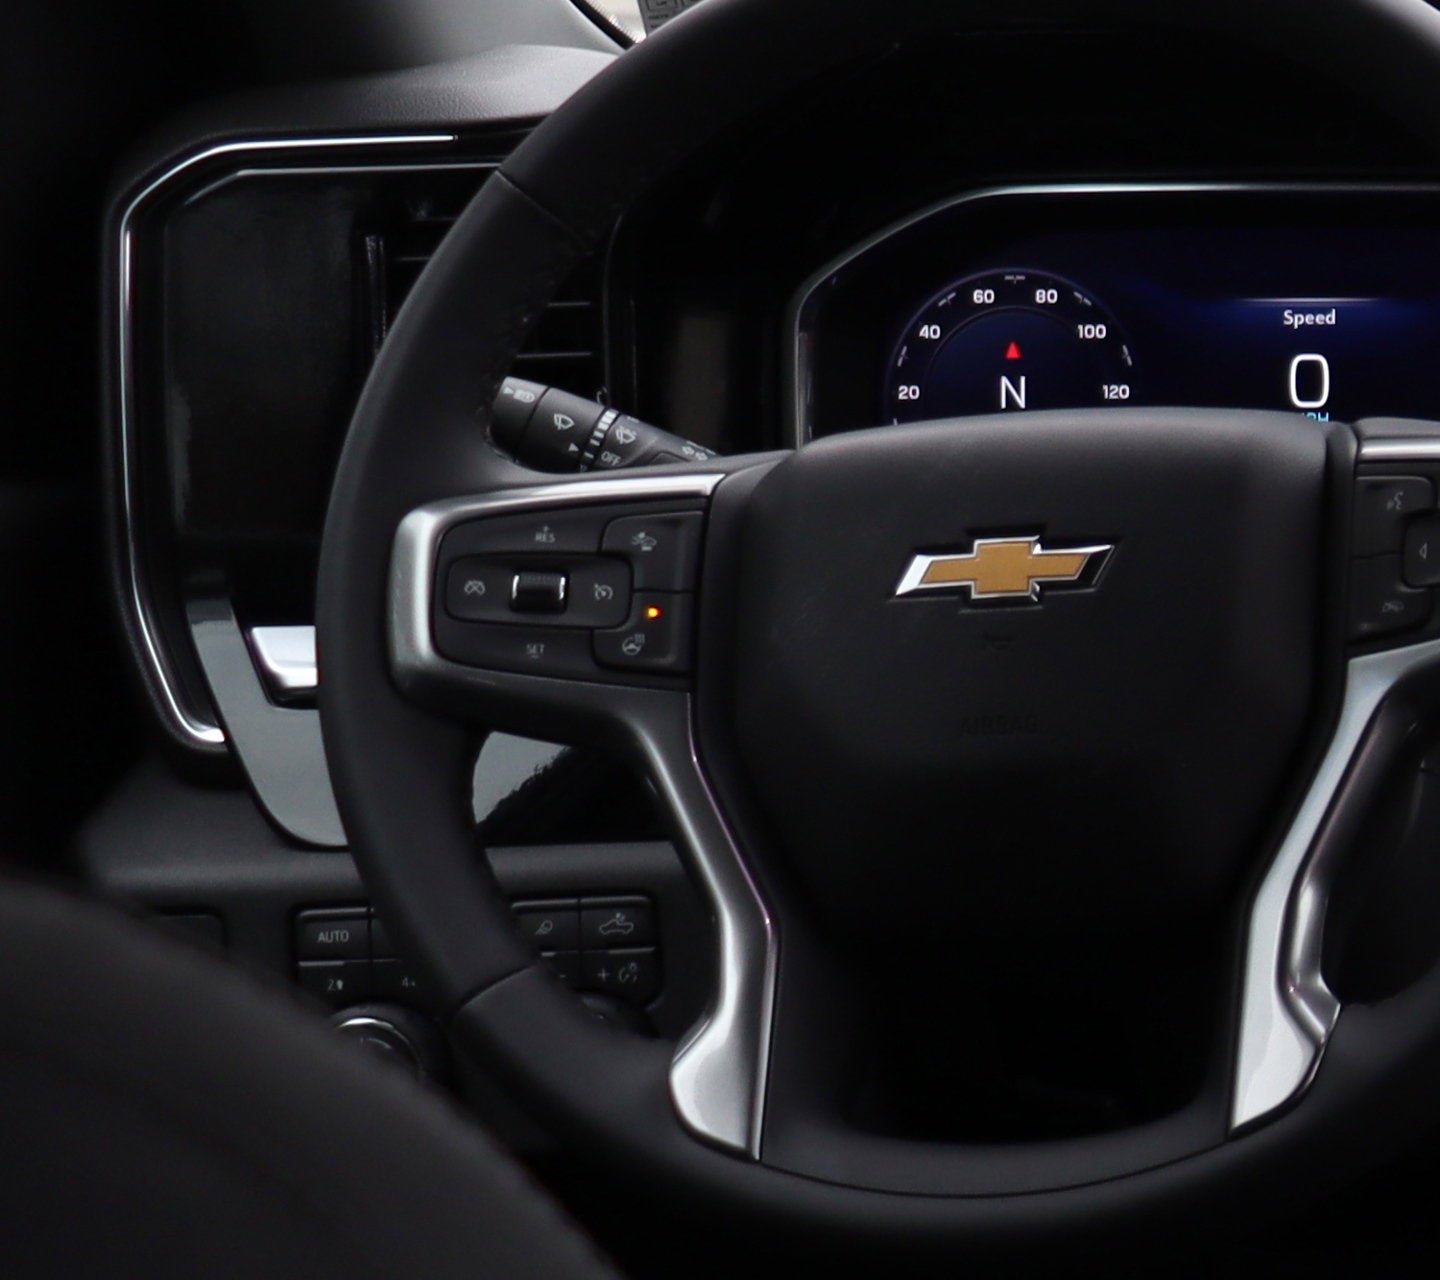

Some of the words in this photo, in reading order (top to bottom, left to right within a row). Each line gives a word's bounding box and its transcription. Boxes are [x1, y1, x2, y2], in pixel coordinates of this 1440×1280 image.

[973, 289, 995, 304] 60
[1035, 289, 1058, 304] 80
[1283, 308, 1336, 329] Speed
[919, 324, 941, 339] 40
[1077, 324, 1107, 339] 100
[1289, 353, 1330, 409] 0
[898, 385, 920, 400] 20
[1000, 375, 1026, 410] N
[1102, 384, 1130, 400] 120
[600, 450, 622, 467] OFF
[534, 531, 555, 544] RES
[526, 643, 545, 655] SET
[317, 930, 350, 943] AUTO
